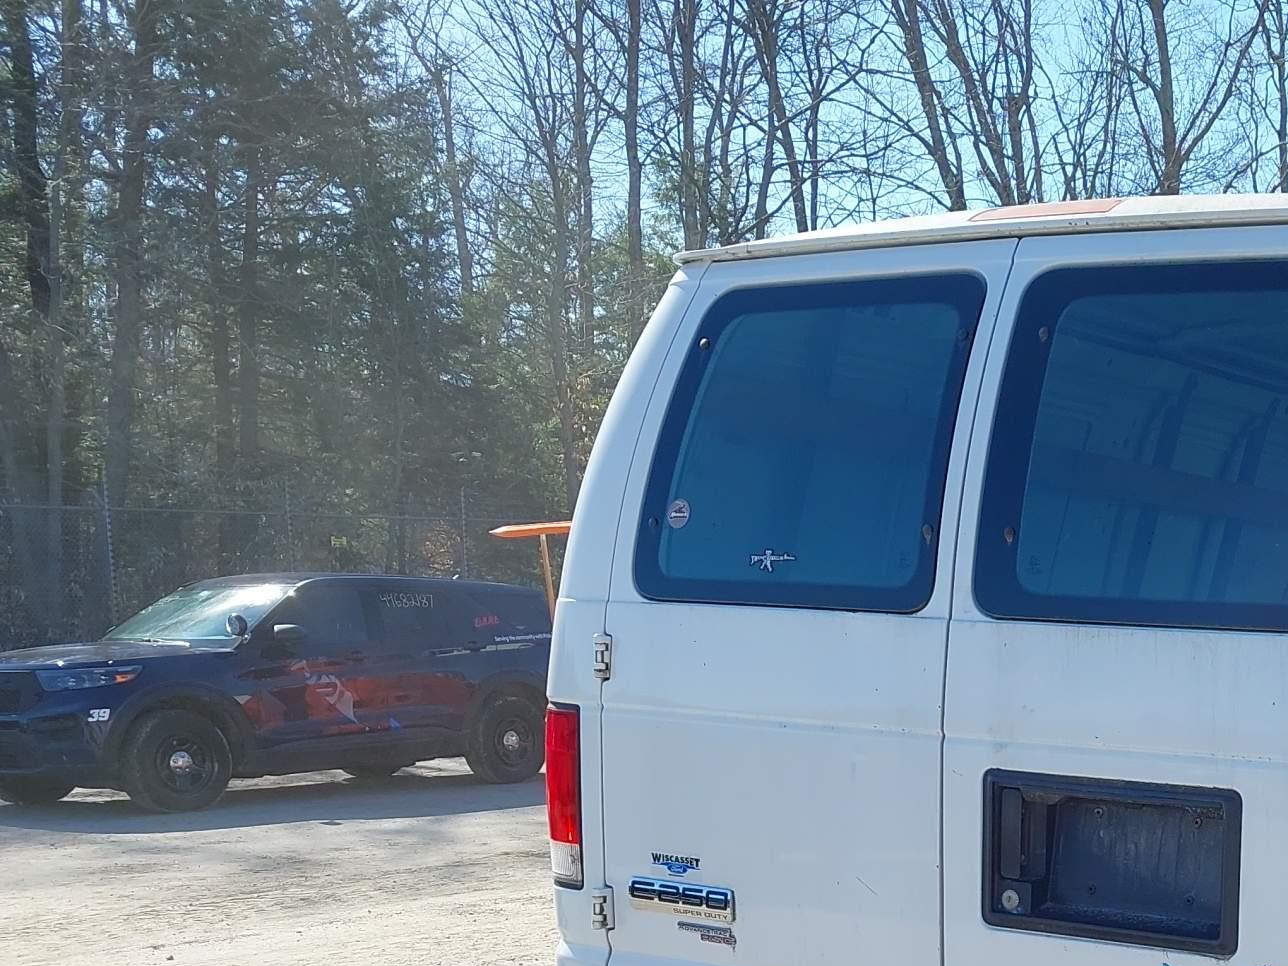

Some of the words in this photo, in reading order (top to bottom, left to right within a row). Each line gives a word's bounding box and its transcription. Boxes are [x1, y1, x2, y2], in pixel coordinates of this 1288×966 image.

[87, 708, 111, 722] 39
[651, 852, 701, 868] WISCASSET
[673, 907, 702, 917] SUPER
[703, 912, 728, 921] DUTY
